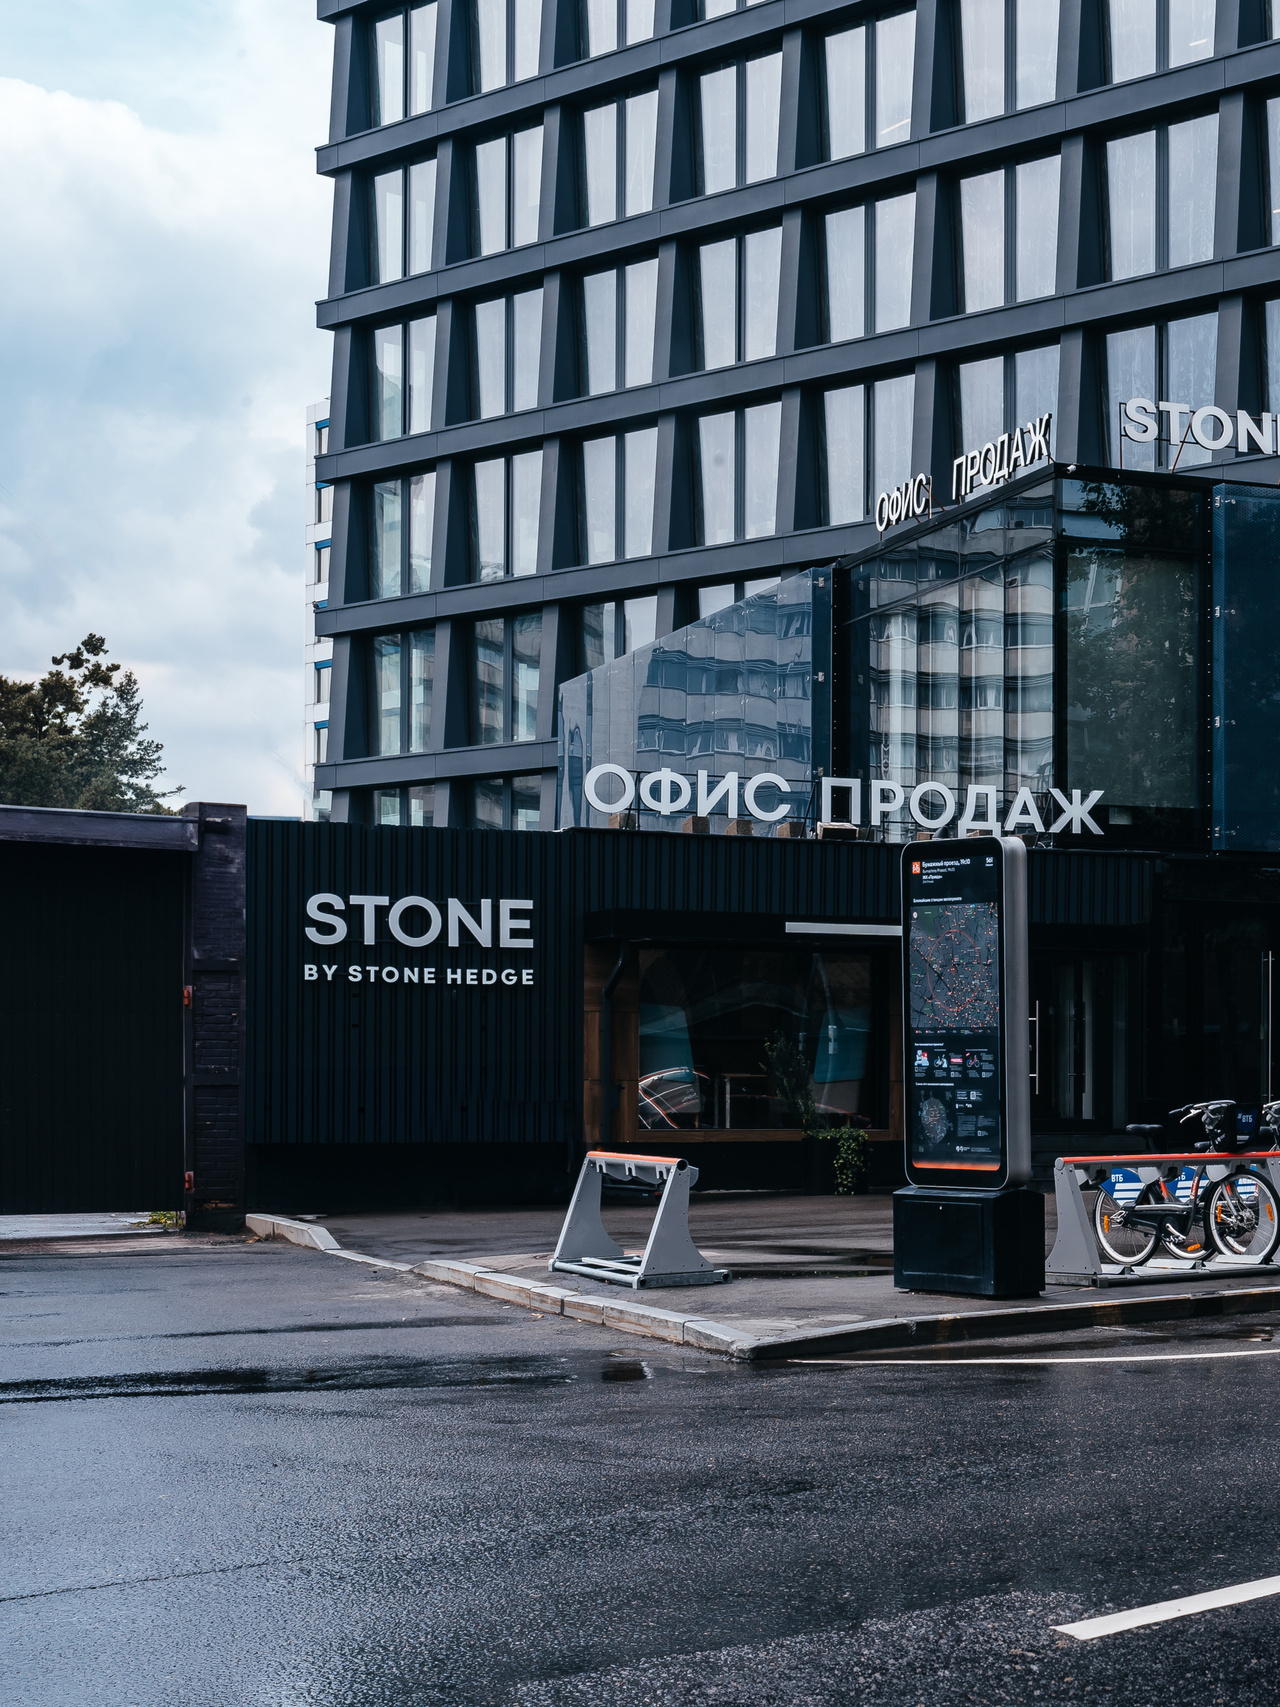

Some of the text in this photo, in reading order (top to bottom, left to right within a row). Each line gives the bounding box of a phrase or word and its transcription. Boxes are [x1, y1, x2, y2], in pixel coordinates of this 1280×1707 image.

[875, 413, 1052, 532] ОФИС ПРОДАЖ
[584, 763, 1105, 837] ОФИС ПРОДАЖ
[305, 893, 534, 948] STONE
[304, 964, 534, 985] BY STONE HEDGE
[1111, 1173, 1124, 1182] ВТБ
